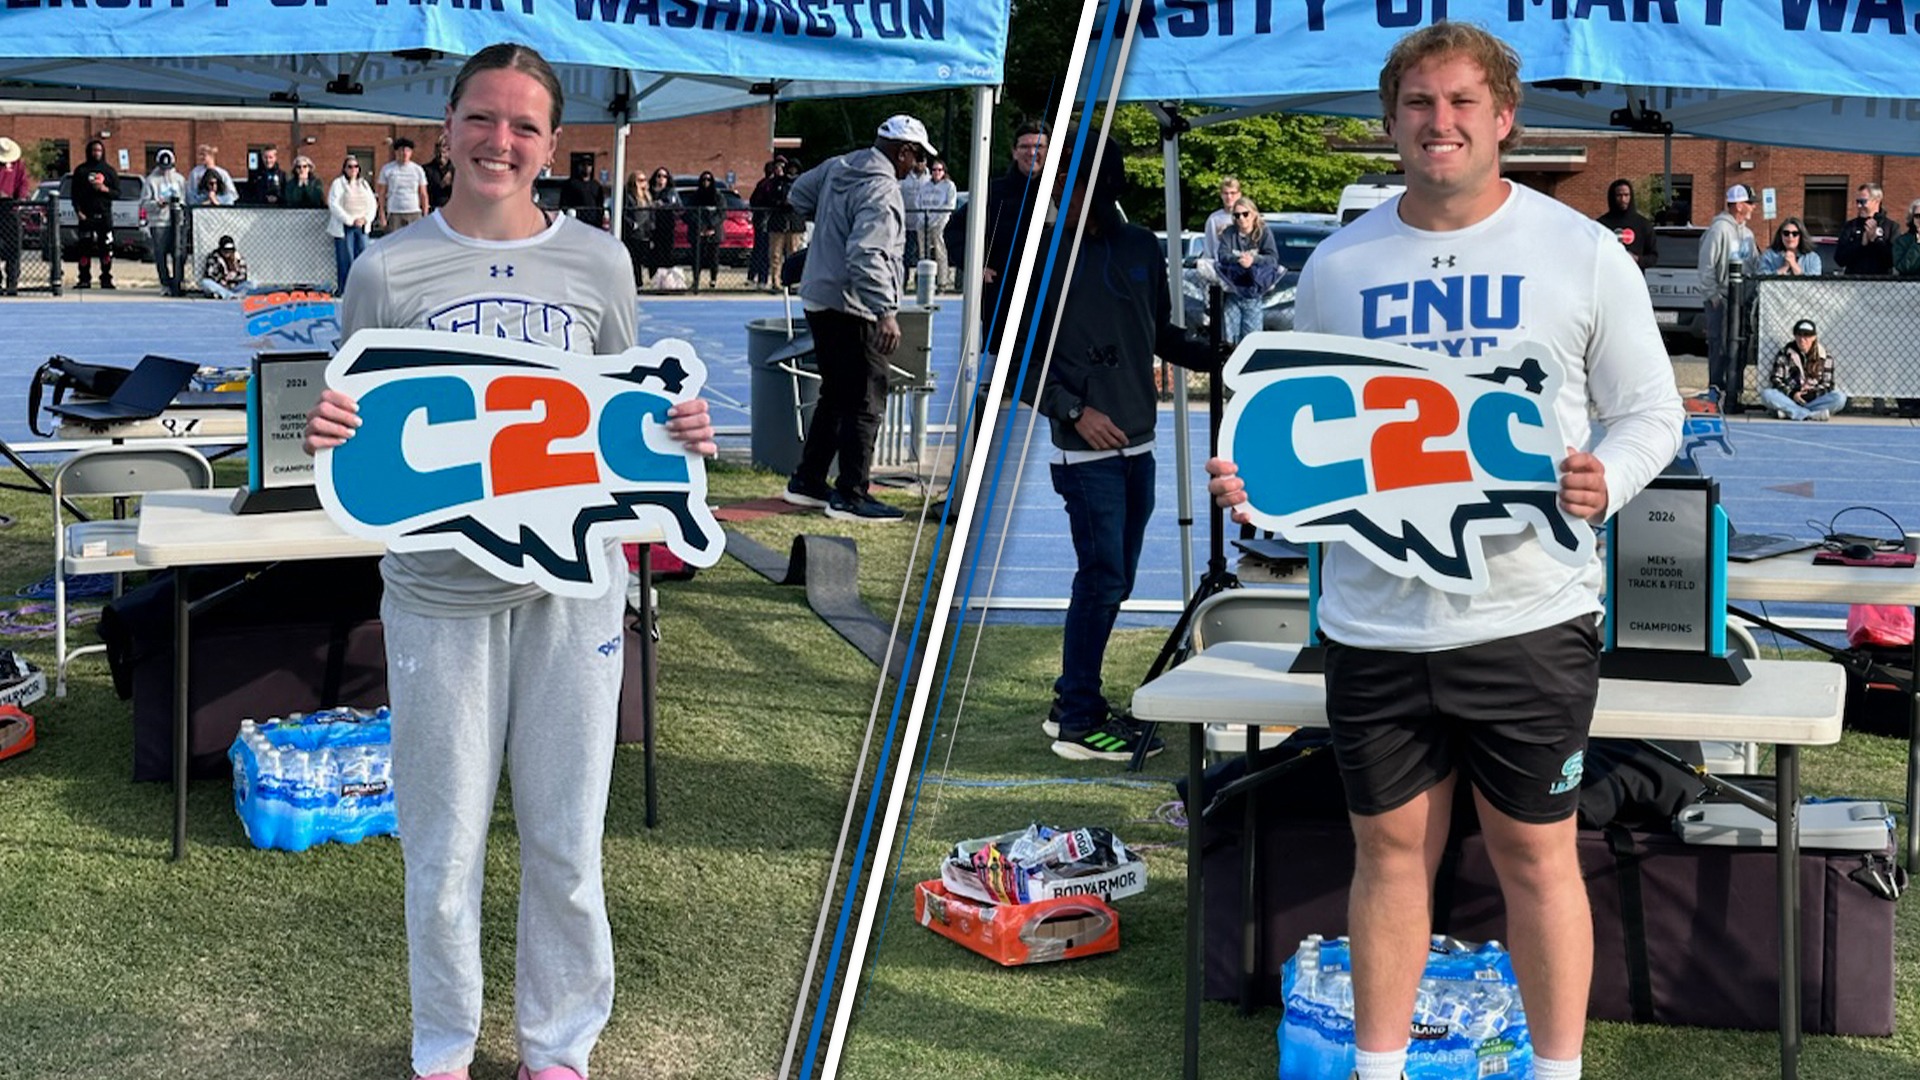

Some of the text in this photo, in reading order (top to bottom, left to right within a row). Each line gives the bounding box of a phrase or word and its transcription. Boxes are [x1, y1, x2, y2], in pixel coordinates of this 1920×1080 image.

[1359, 274, 1526, 340] CNU
[286, 379, 307, 388] 2026
[272, 432, 294, 440] TRACK
[332, 375, 690, 527] C2C
[1232, 375, 1557, 517] C2C
[1649, 511, 1676, 523] 2026
[1647, 556, 1676, 566] MEN'S
[1641, 567, 1683, 578] OUTDOOR
[1628, 579, 1695, 590] TRACK & FIELD
[1629, 621, 1693, 634] CHAMPIONS
[1053, 870, 1137, 899] BODYARMOR
[1423, 1049, 1469, 1064] water
